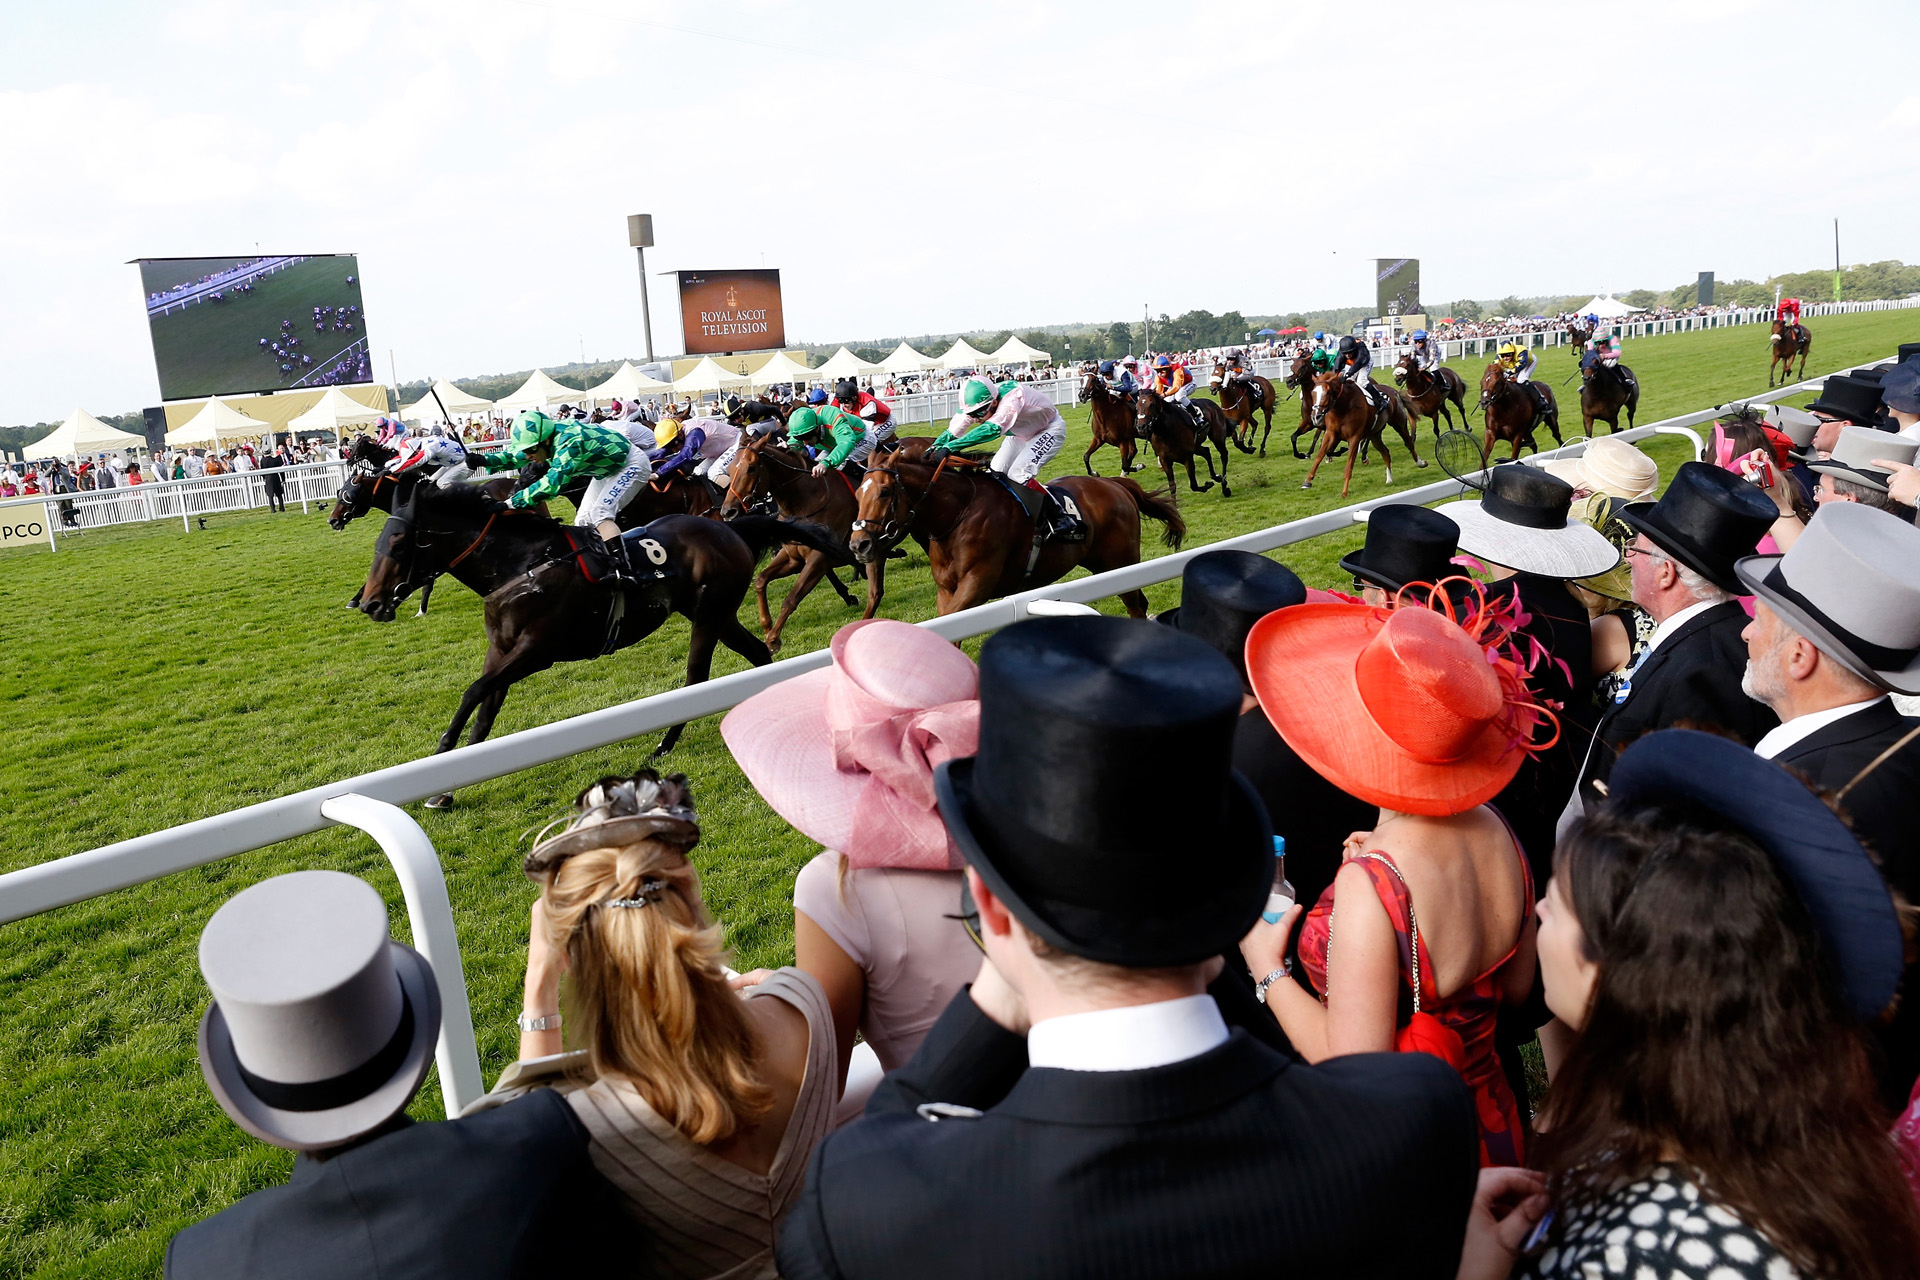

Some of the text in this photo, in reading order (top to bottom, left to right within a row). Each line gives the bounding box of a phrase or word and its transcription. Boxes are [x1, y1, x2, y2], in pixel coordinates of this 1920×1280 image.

[701, 309, 766, 323] ROYAL ASCOT
[702, 322, 768, 336] TELEVISION
[1030, 432, 1052, 454] ALBERT
[1031, 436, 1056, 464] BARTLETT
[608, 485, 622, 498] DE
[603, 497, 614, 505] S.
[0, 522, 42, 540] PCO
[638, 538, 668, 565] 8
